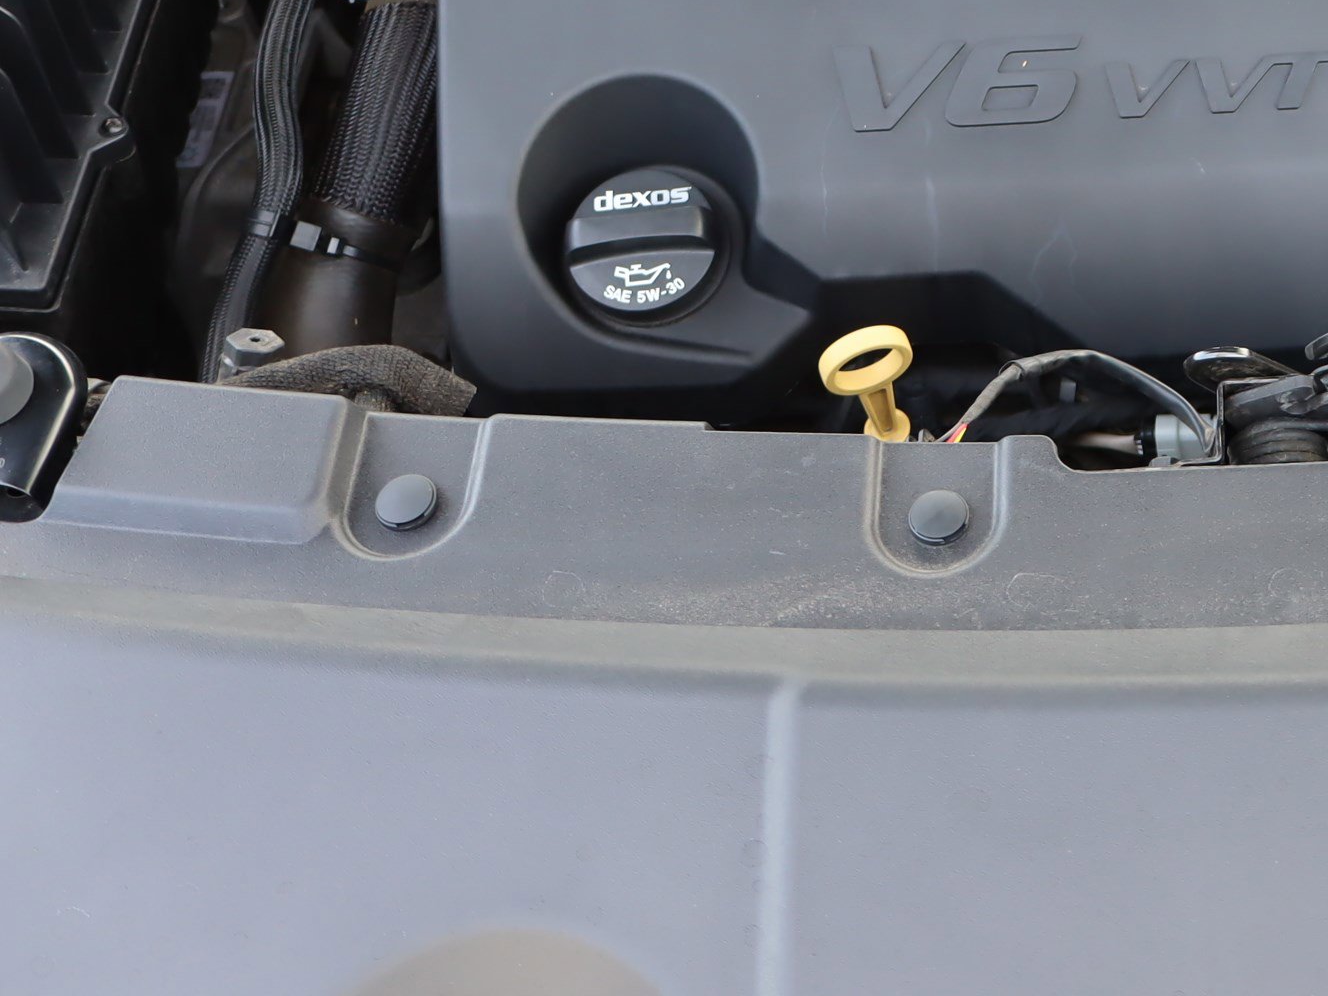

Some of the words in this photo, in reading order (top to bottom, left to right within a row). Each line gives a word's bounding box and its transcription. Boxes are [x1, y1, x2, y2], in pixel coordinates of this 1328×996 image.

[832, 33, 1083, 134] V6
[593, 186, 692, 212] dexos
[603, 285, 632, 304] SAE
[637, 277, 686, 304] 5W-30
